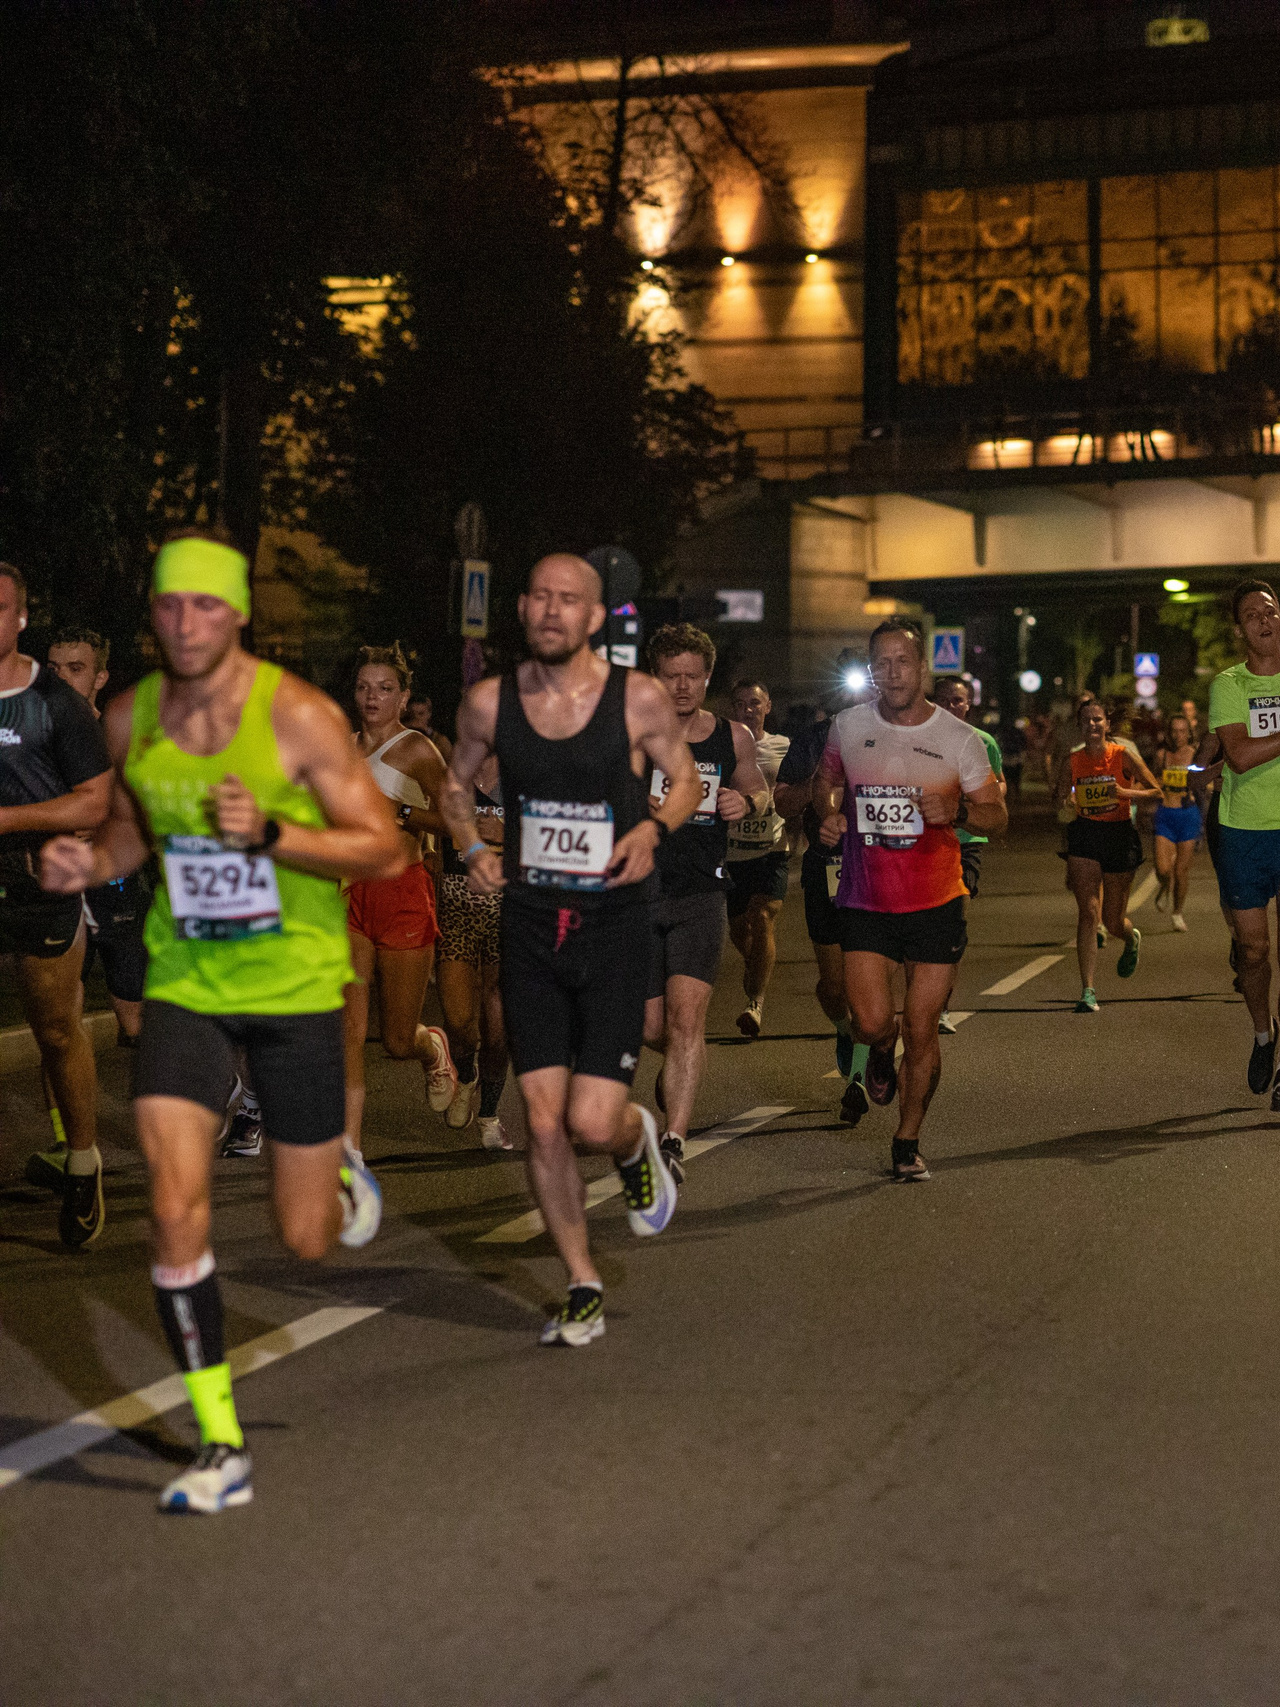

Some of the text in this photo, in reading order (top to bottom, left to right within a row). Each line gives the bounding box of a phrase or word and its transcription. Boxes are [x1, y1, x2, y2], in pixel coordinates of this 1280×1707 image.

[912, 746, 943, 760] wbteam
[1085, 787, 1109, 800] 864
[865, 803, 915, 823] 8632
[737, 820, 768, 835] 1829
[539, 826, 591, 855] 704
[180, 852, 267, 897] 5294
